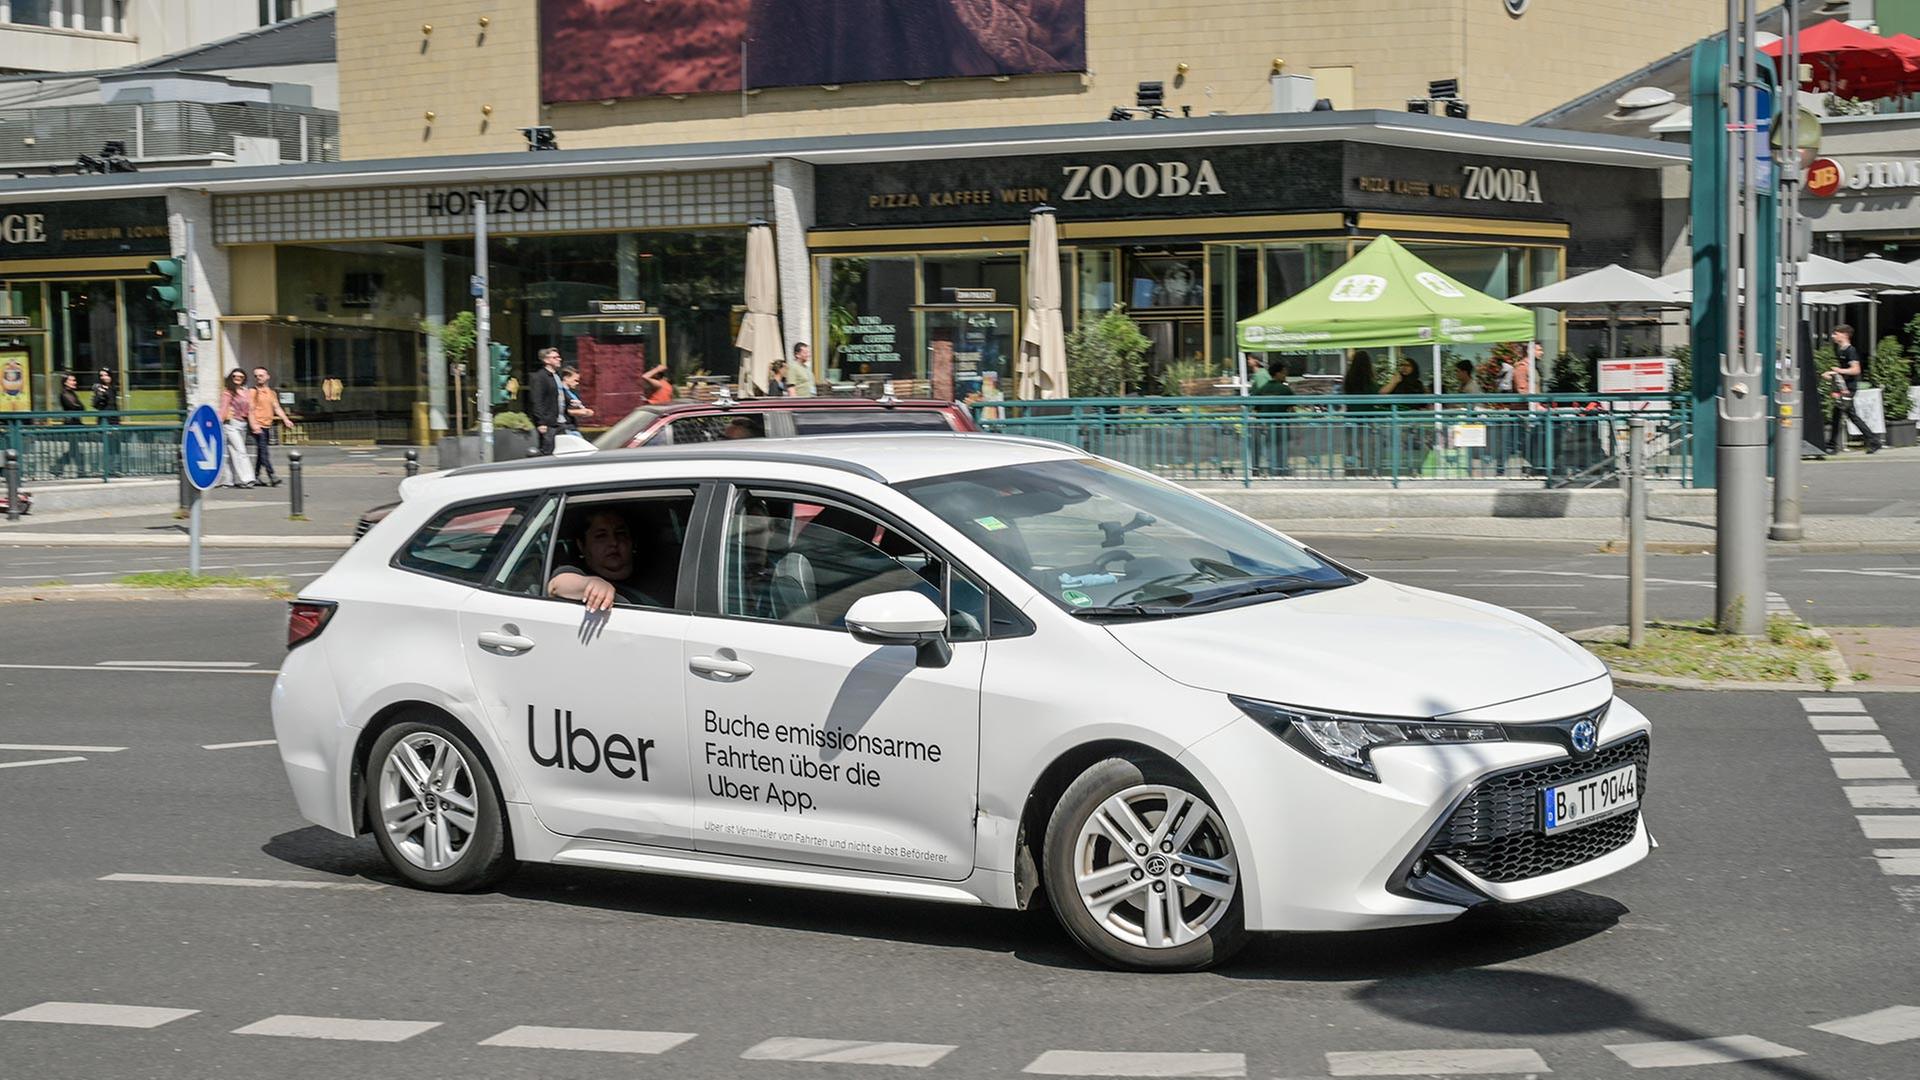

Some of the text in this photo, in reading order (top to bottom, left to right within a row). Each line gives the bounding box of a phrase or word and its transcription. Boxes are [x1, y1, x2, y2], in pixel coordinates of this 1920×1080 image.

[869, 187, 1048, 208] PIZZA KAFFEE WEIN
[1061, 159, 1226, 200] ZOOBA
[1463, 165, 1543, 204] ZOOBA
[1807, 166, 1838, 189] JB
[426, 187, 548, 217] HORIZON
[0, 213, 47, 244] GE
[528, 704, 655, 783] Uber
[704, 709, 942, 763] Buche emissionsarme
[705, 742, 881, 788] Fahrten über die
[708, 773, 817, 815] Uber App.
[1556, 791, 1567, 820] B
[1578, 781, 1597, 814] TT
[1601, 770, 1634, 807] 9044
[704, 820, 724, 832] Uber
[725, 823, 735, 834] ist
[736, 824, 777, 840] Vermittler
[779, 832, 794, 841] von
[796, 832, 828, 847] Fahrten
[829, 839, 846, 849] und
[848, 840, 871, 853] nicht
